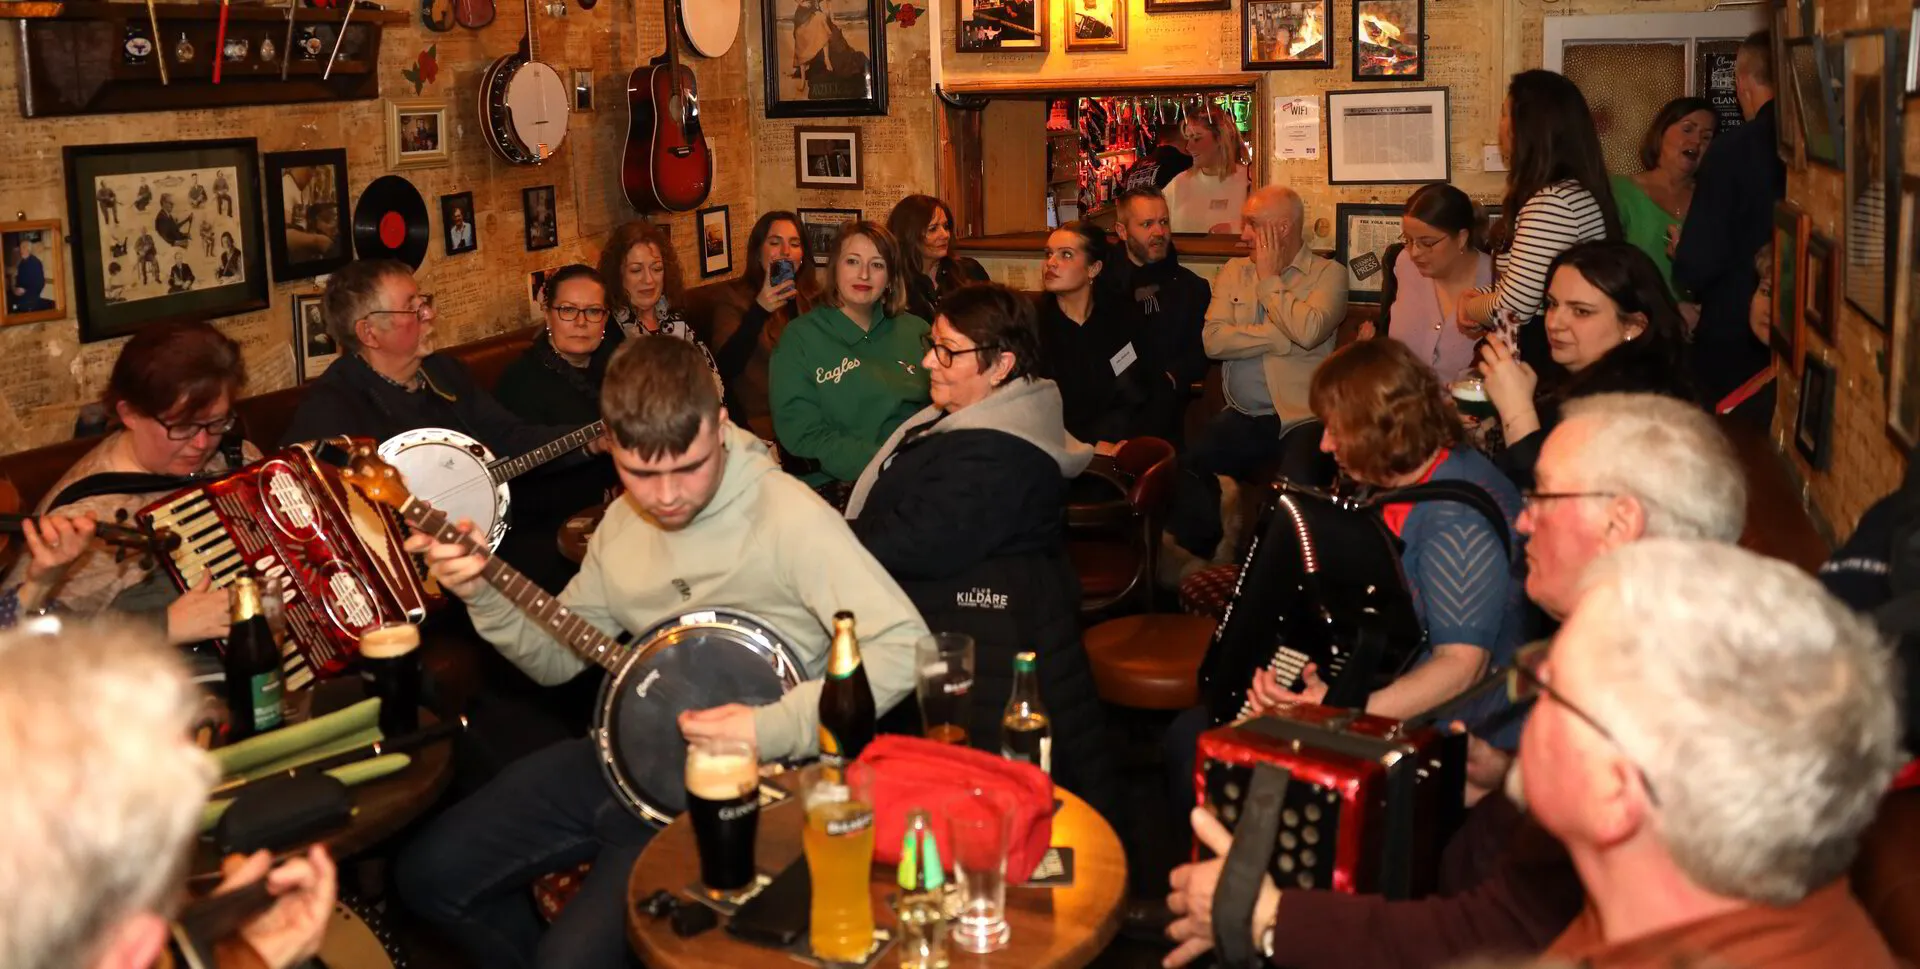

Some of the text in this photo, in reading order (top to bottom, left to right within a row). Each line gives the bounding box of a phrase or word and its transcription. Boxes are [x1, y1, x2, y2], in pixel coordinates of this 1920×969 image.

[1355, 260, 1378, 276] PRESS
[816, 357, 861, 384] Eagles
[956, 591, 1009, 606] KILDARE
